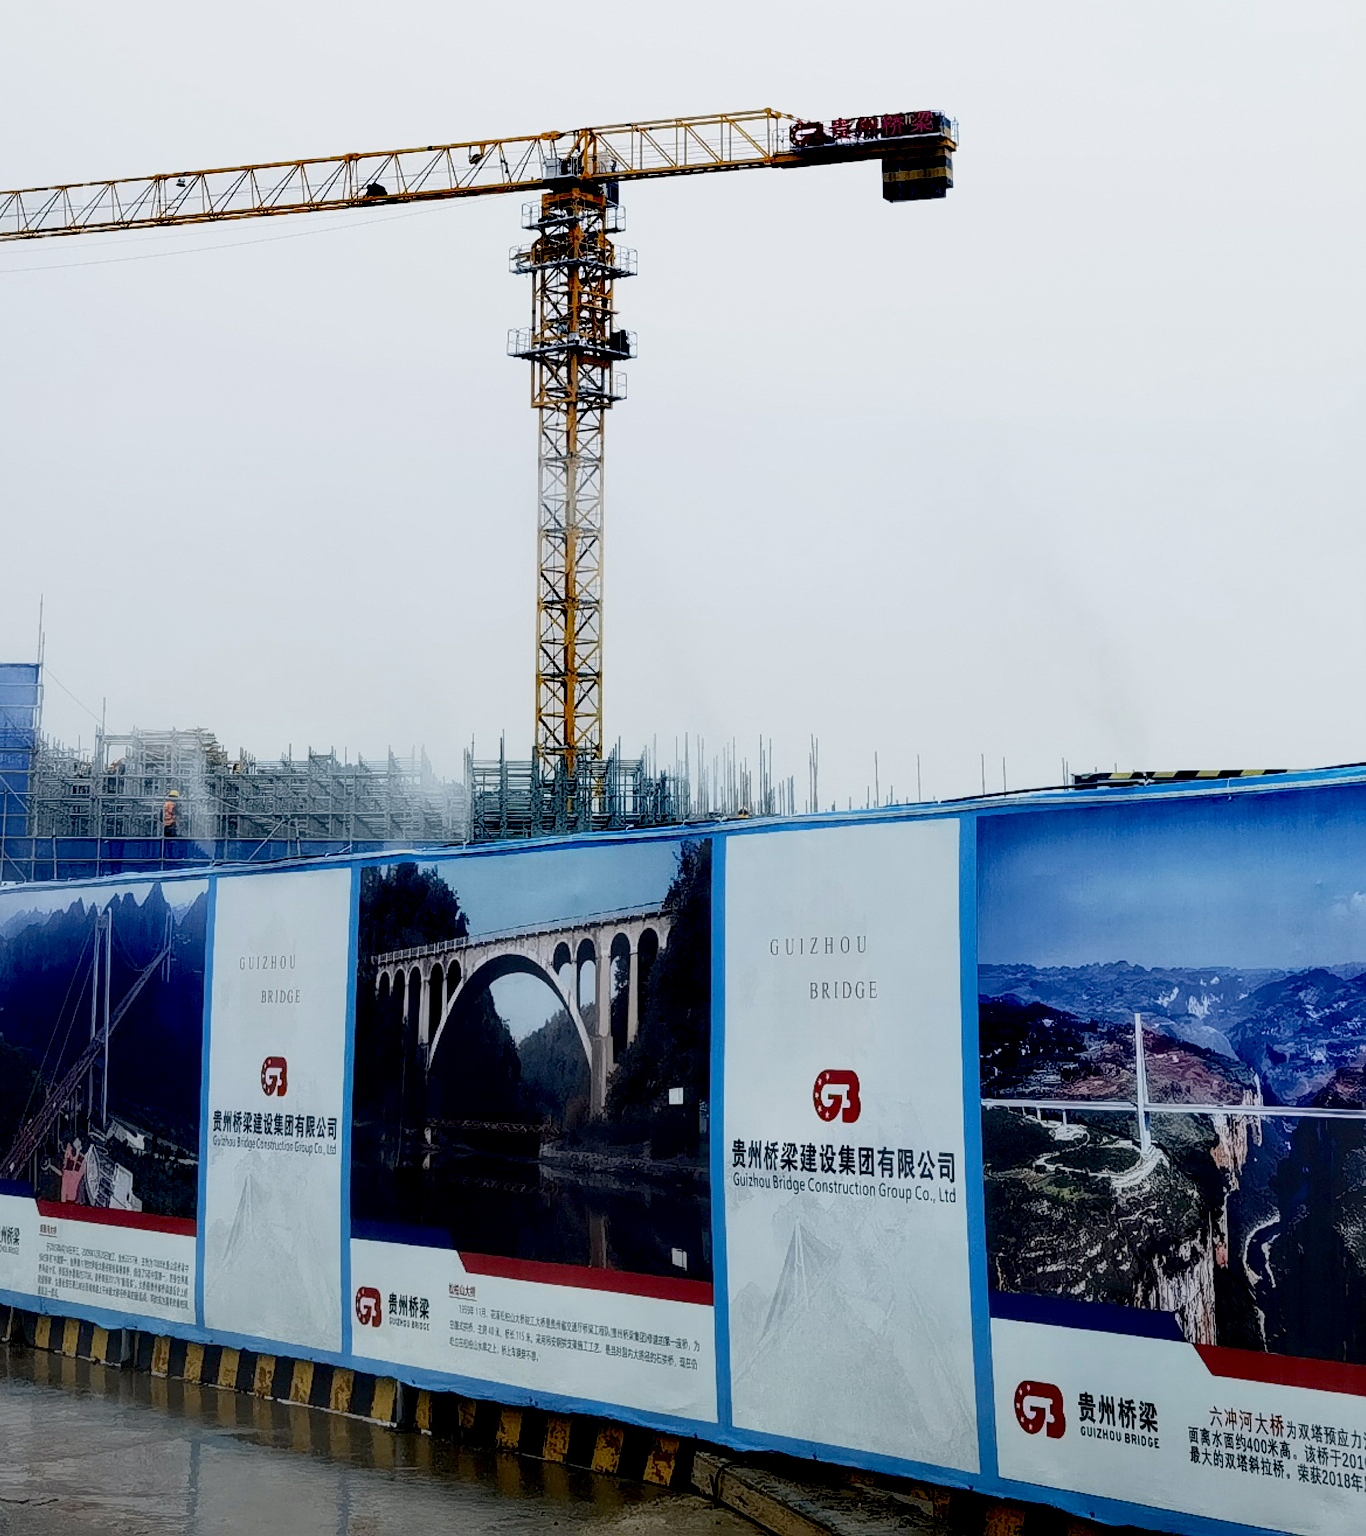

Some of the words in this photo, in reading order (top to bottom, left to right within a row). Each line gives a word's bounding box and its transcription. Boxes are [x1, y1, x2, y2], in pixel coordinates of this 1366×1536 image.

[770, 936, 868, 956] GUIZHOU
[240, 955, 296, 971] GUIZHOU
[261, 990, 301, 1004] BRIDGE
[810, 981, 878, 1000] BRIDGE
[213, 1110, 337, 1140] 贵州桥梁建设集团有限公司
[732, 1139, 956, 1183] 贵州桥梁建设集团有限公司
[733, 1172, 771, 1189] Guizhou
[773, 1176, 806, 1193] Bridge
[808, 1178, 876, 1197] Construction
[879, 1184, 912, 1204] Group
[939, 1187, 956, 1203] Ltd
[388, 1292, 429, 1321] 贵州桥梁
[1078, 1392, 1158, 1433] 贵州桥梁
[1080, 1426, 1122, 1442] GUIZHOU
[1124, 1433, 1160, 1449] BRIDGE
